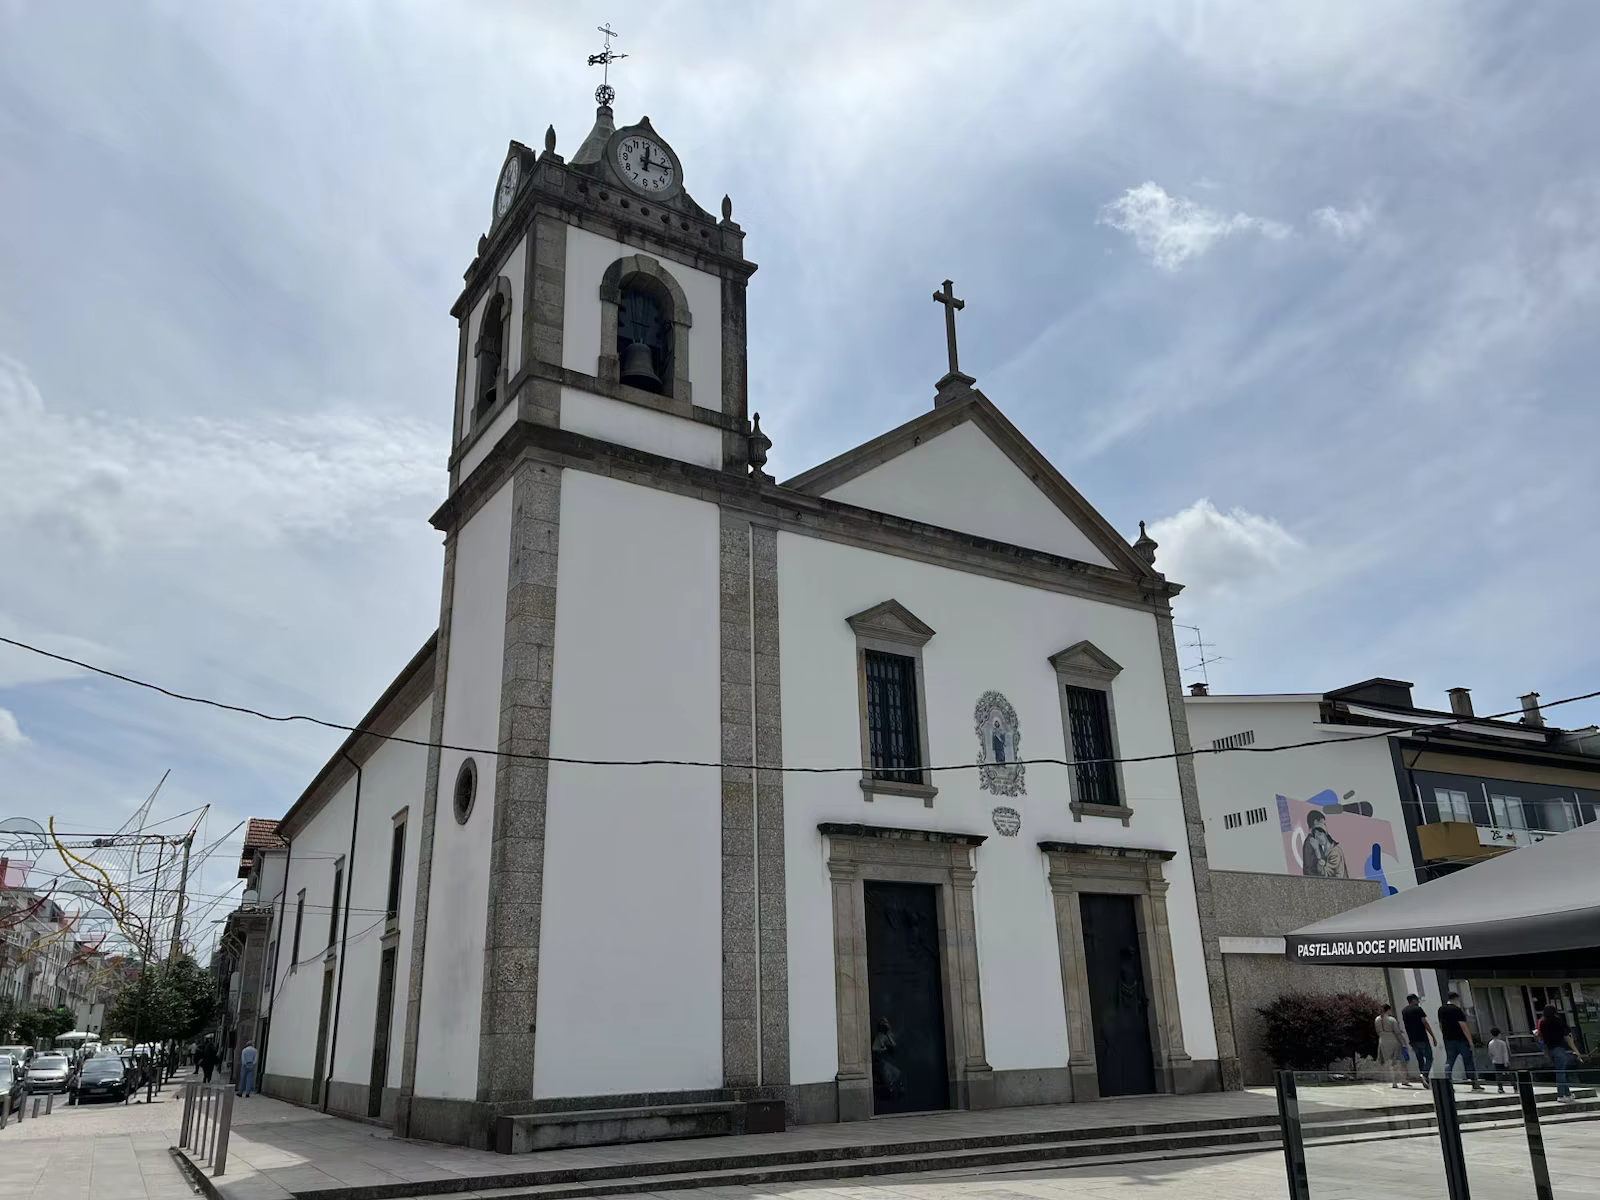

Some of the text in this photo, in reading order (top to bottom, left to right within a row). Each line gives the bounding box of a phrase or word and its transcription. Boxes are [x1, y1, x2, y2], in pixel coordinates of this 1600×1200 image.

[624, 144, 633, 153] 10
[633, 140, 639, 149] 11
[622, 152, 628, 161] 9
[660, 157, 666, 165] 2
[625, 162, 631, 171] 8
[632, 172, 639, 181] 7
[659, 175, 665, 184] 4
[642, 178, 648, 187] 6
[652, 179, 659, 188] 5
[1297, 935, 1462, 957] PASTELARIA DOCE PIMENTINHA
